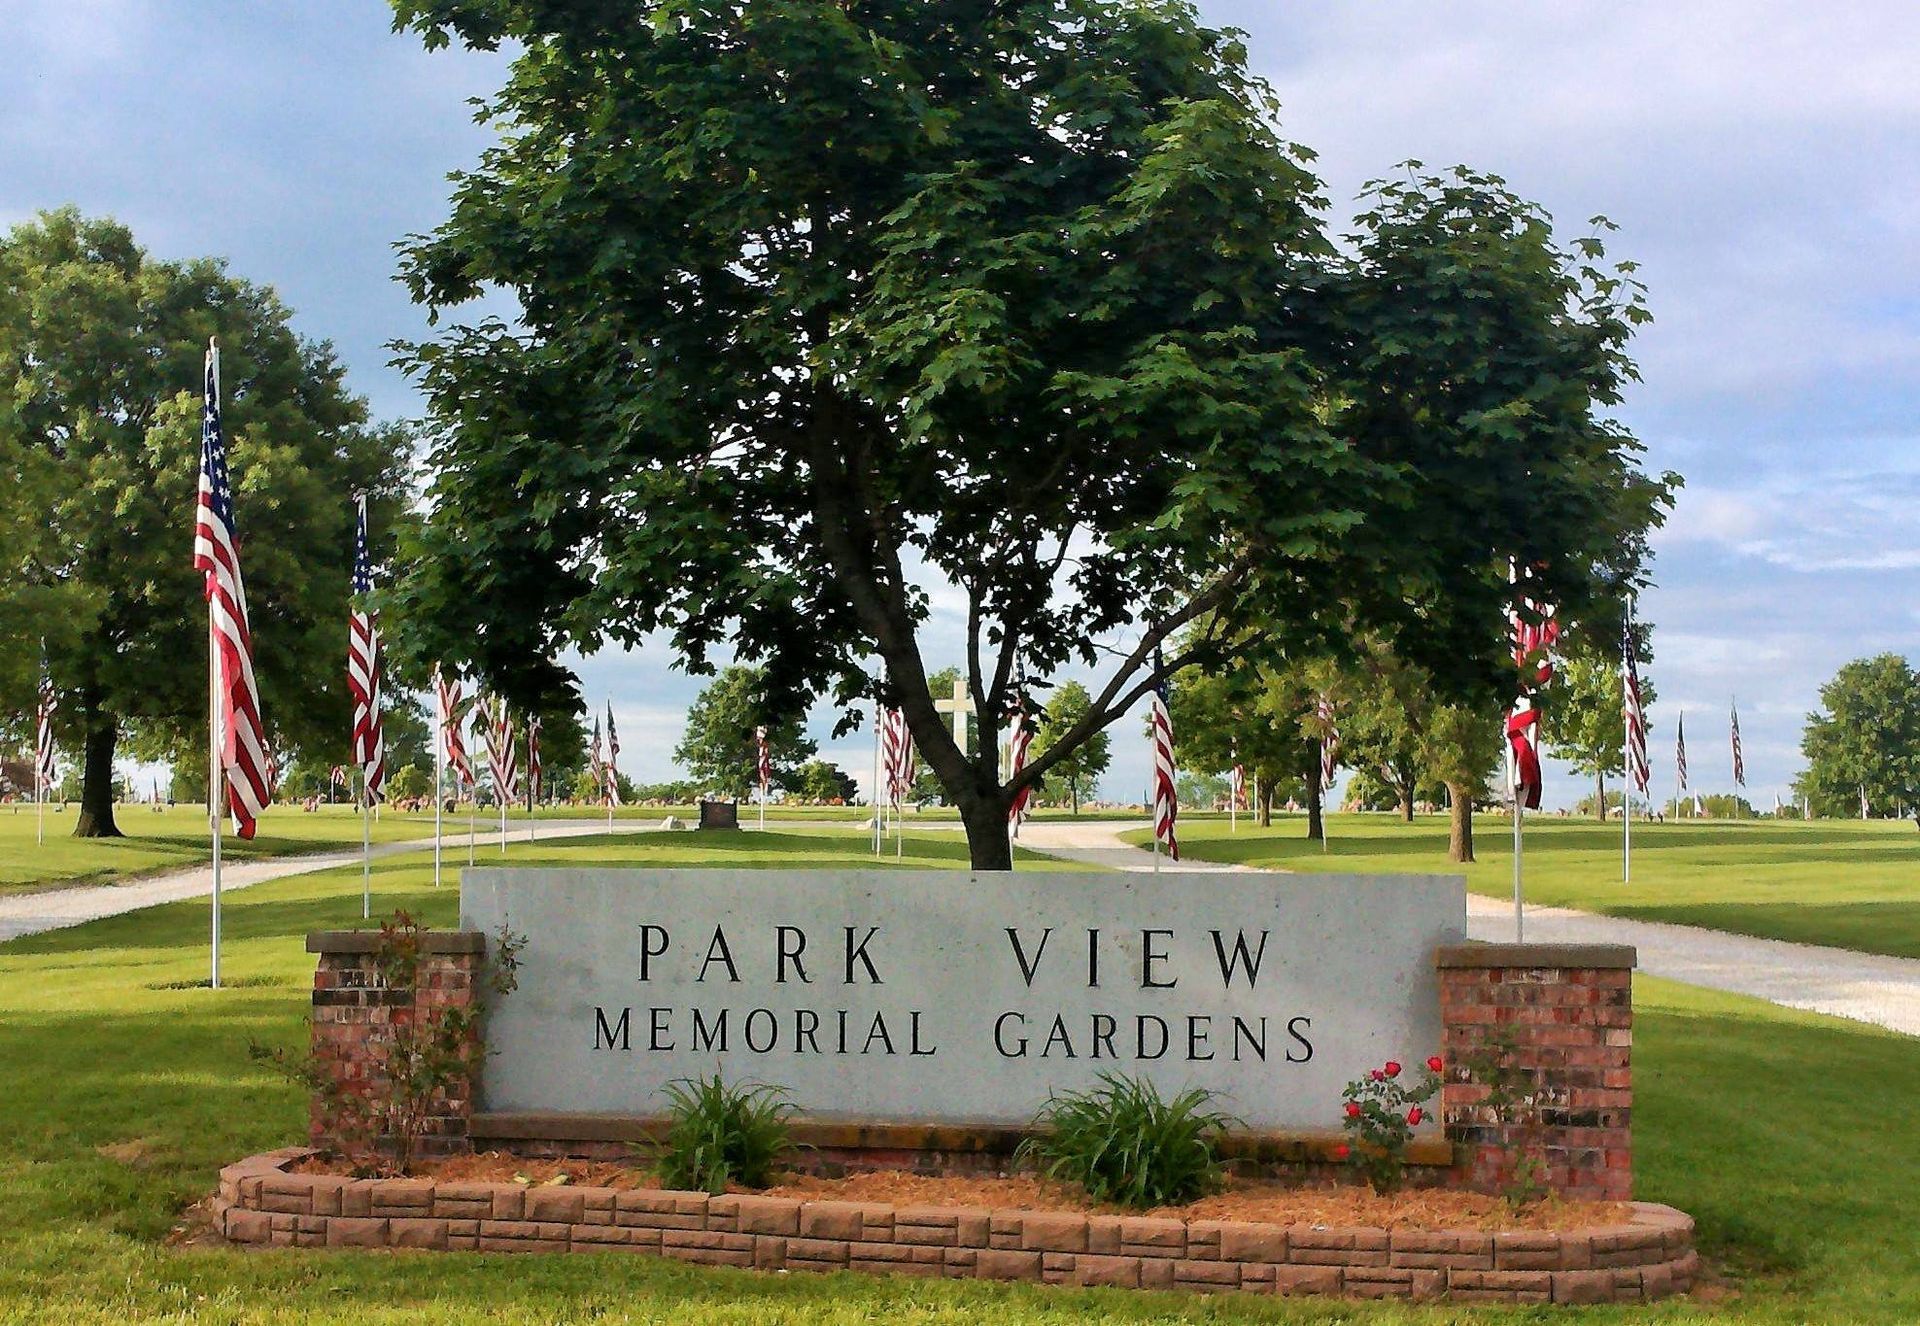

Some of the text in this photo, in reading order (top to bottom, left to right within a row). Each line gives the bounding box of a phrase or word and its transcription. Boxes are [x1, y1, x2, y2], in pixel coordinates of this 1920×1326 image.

[637, 923, 1272, 990] PARK VIEW
[592, 1006, 1315, 1064] MEMORIAL GARDENS
